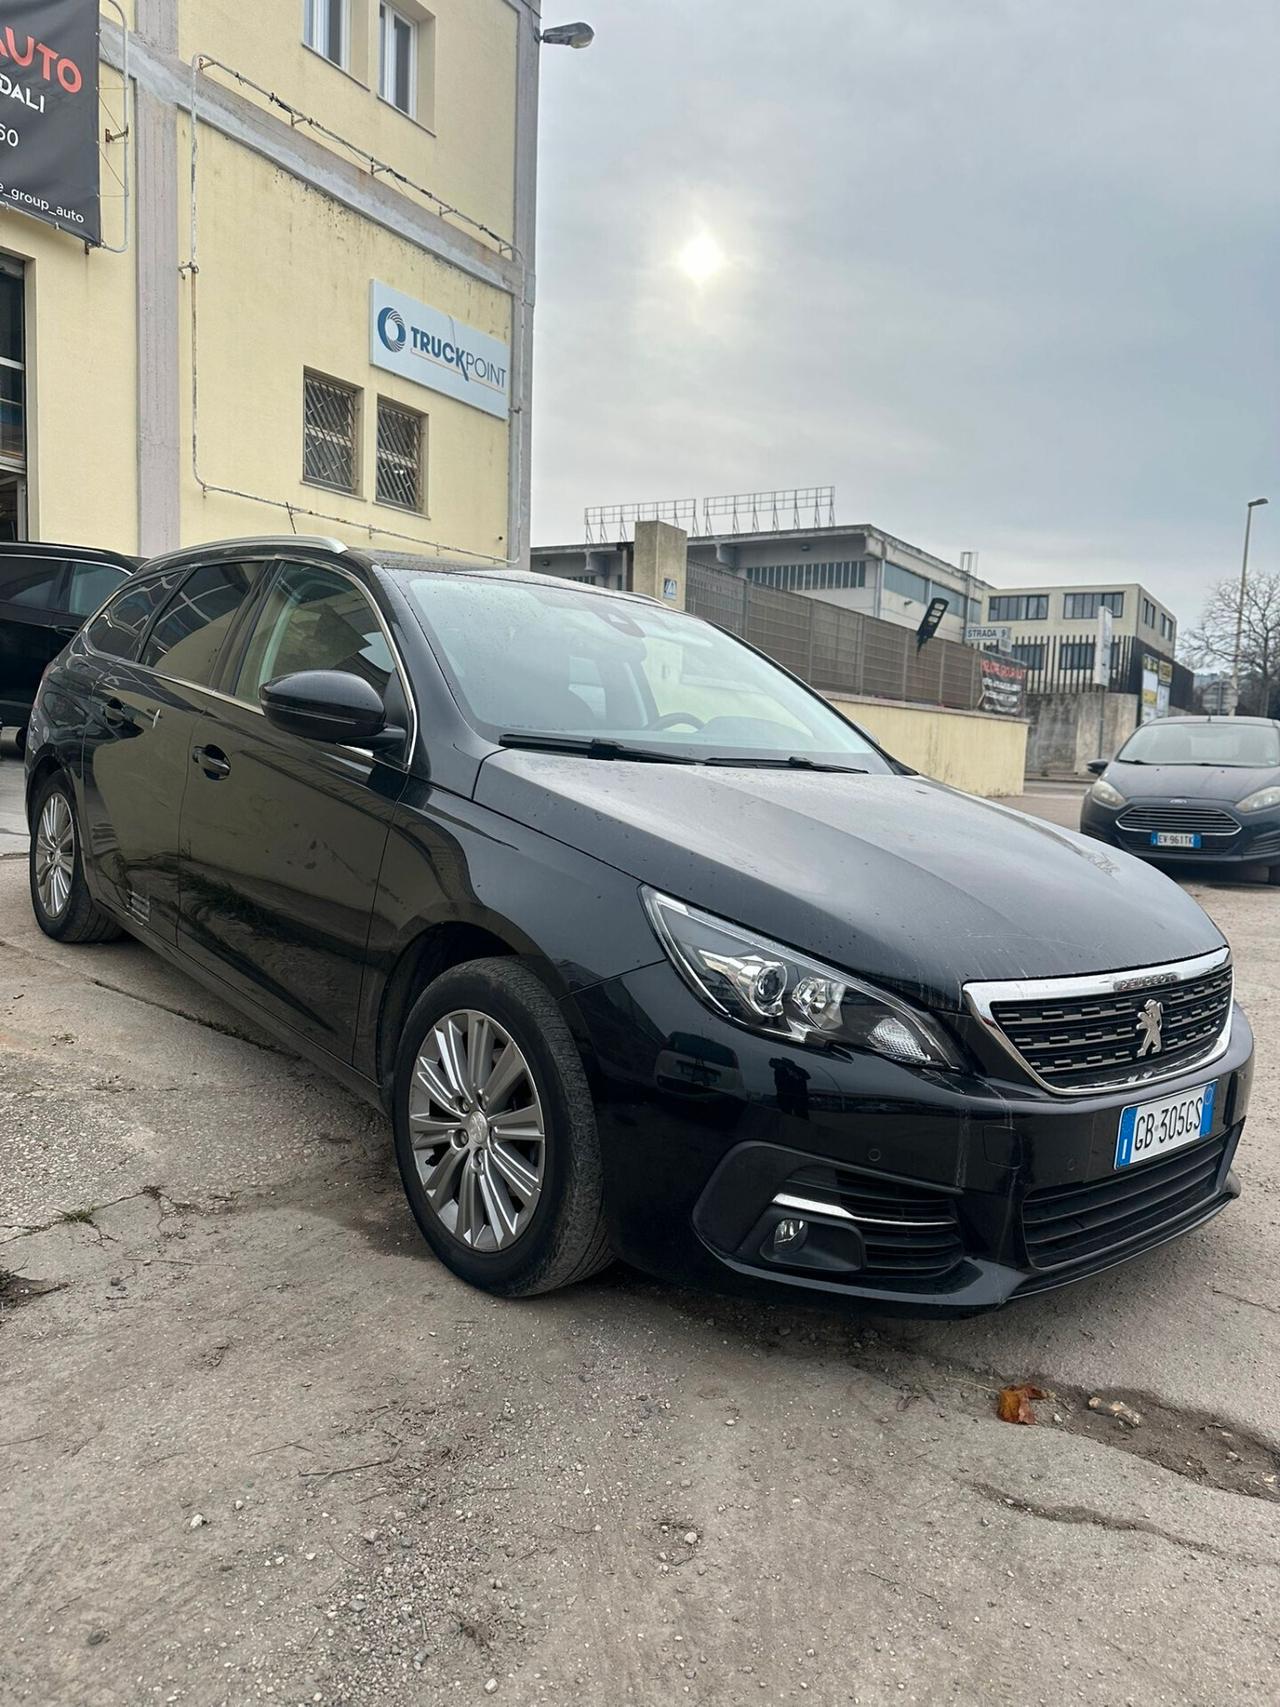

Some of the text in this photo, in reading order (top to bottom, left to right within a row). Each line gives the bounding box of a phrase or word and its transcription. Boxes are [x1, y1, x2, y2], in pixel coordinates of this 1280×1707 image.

[410, 326, 507, 388] TRUCKPOINT
[967, 629, 997, 638] STRADA
[1158, 1097, 1203, 1144] 305GS
